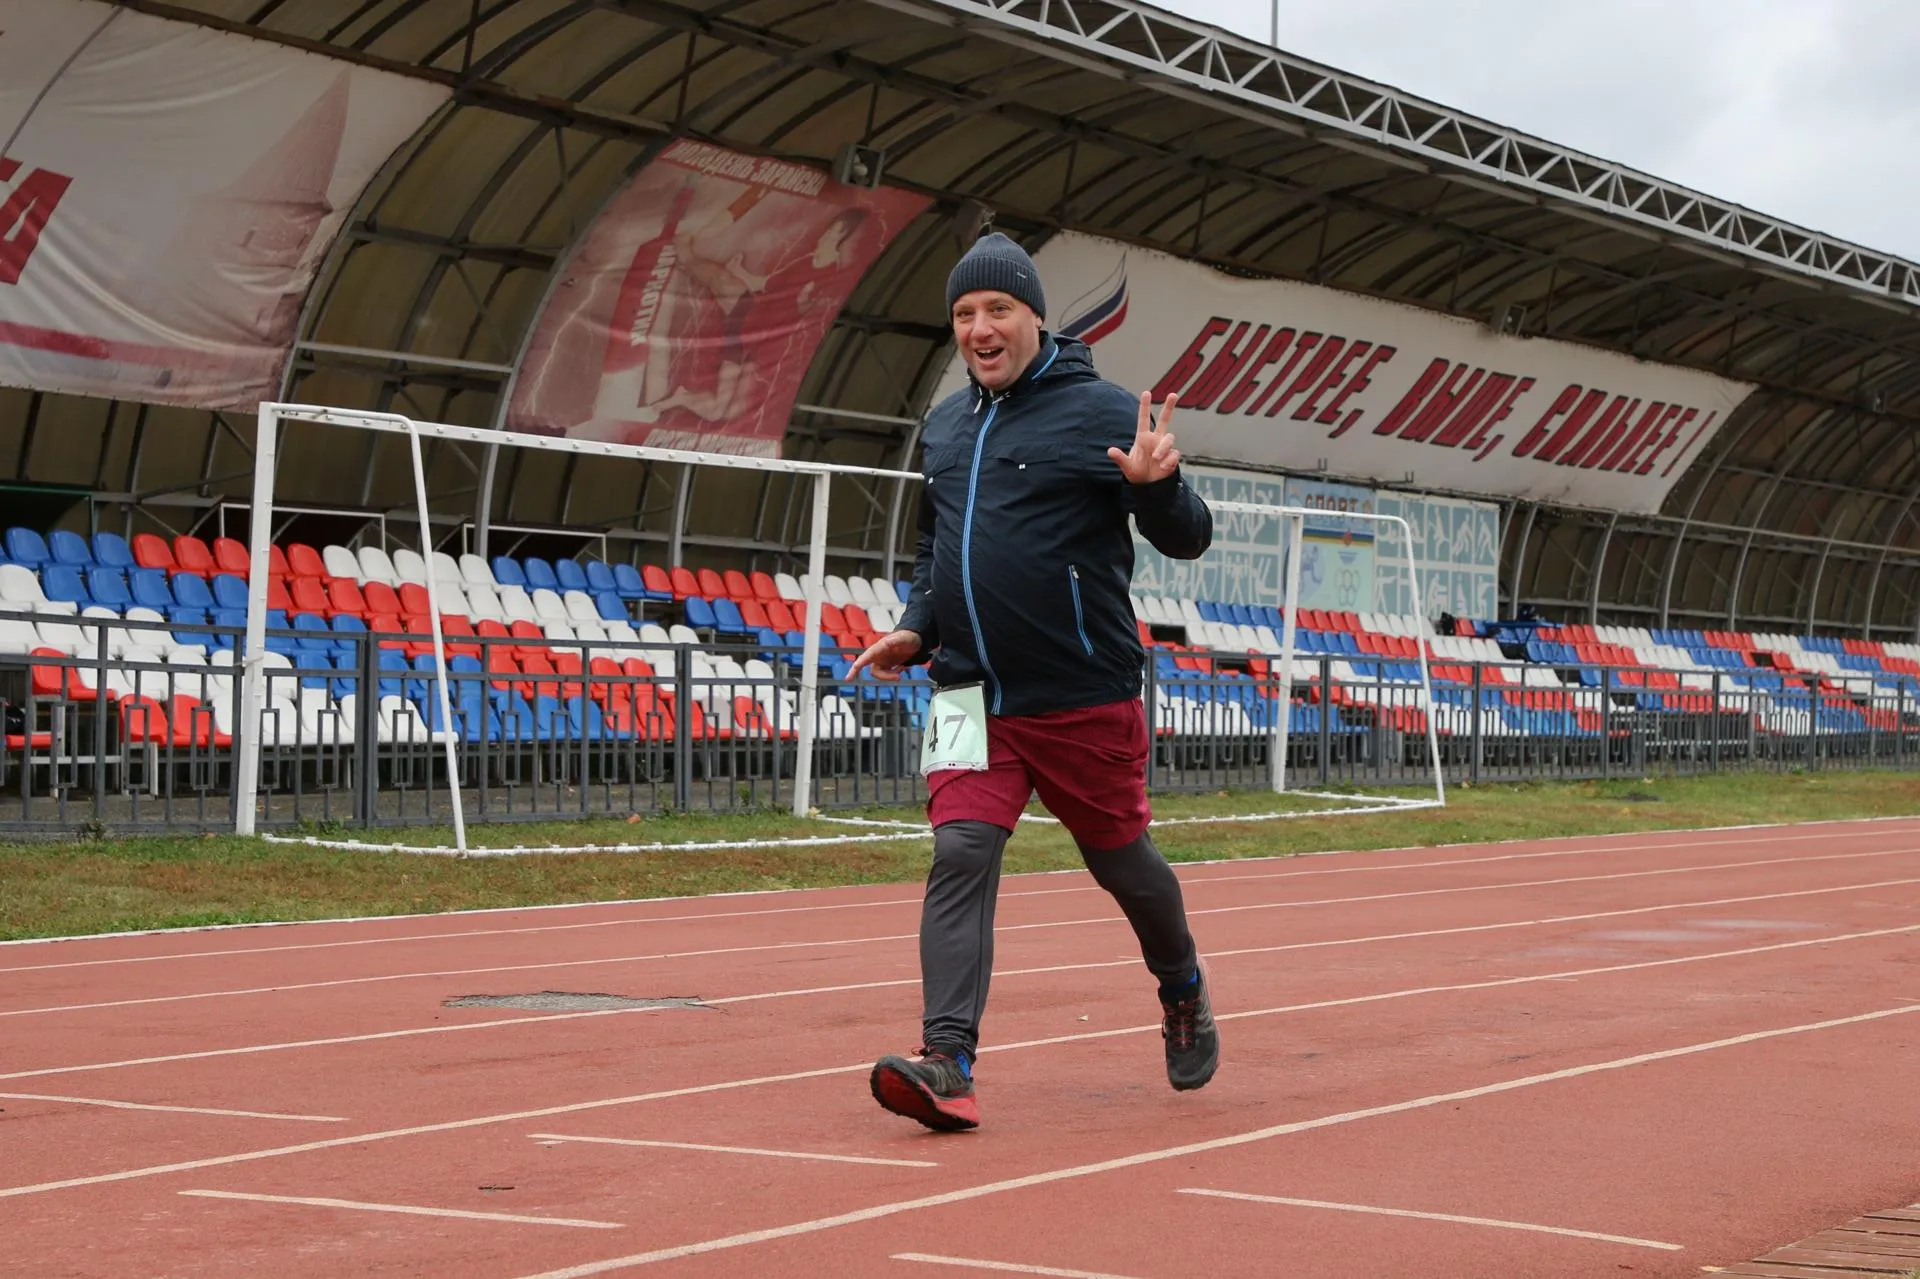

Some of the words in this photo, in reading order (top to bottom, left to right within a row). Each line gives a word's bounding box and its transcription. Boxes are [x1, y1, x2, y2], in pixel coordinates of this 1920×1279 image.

[629, 244, 677, 347] НАРКОТИК
[1150, 316, 1398, 439] БЫСТРЕЕ,
[1372, 357, 1537, 462] ВЫШЕ,
[1511, 384, 1718, 478] СИЛЬНЕЕ!
[928, 714, 968, 753] 47
